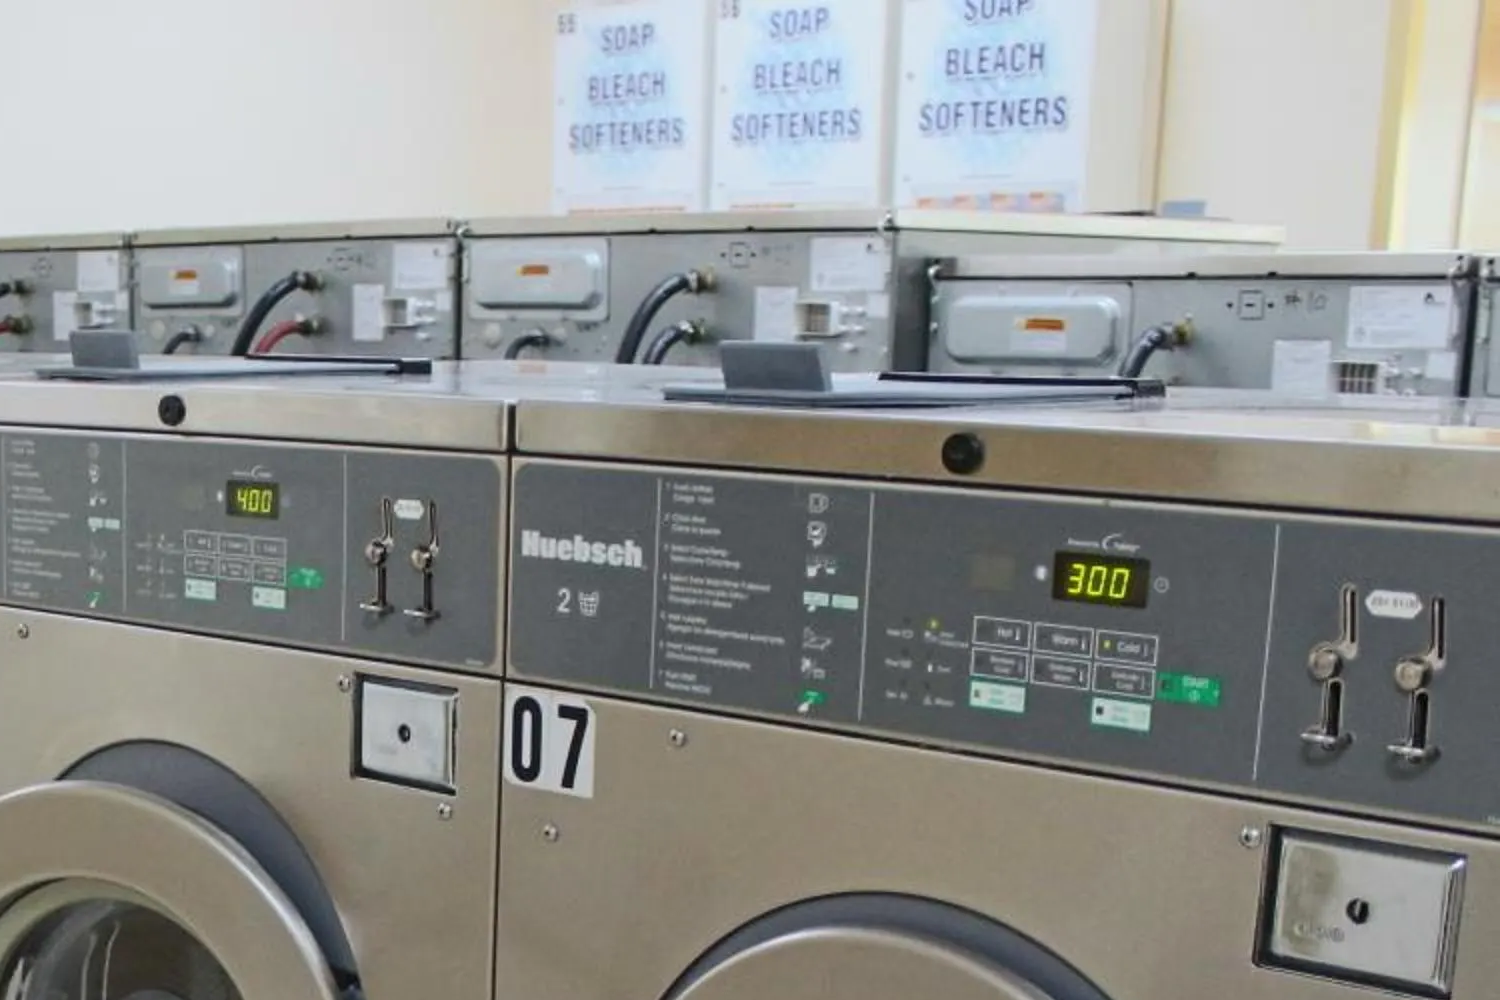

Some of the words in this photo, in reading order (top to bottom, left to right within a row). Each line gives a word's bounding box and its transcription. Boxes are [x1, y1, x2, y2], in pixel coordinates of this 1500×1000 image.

[601, 22, 655, 53] SOAP
[769, 7, 830, 40] SOAP
[753, 57, 843, 91] BLEACH
[945, 42, 1047, 78] BLEACH
[587, 70, 667, 103] BLEACH
[731, 106, 863, 143] SOFTENERS
[918, 95, 1070, 133] SOFTENERS
[568, 116, 686, 151] SOFTENERS
[236, 488, 274, 514] 400
[521, 529, 644, 569] Huebsch
[1066, 562, 1132, 600] 300
[556, 587, 572, 613] 2
[511, 695, 589, 789] 07
